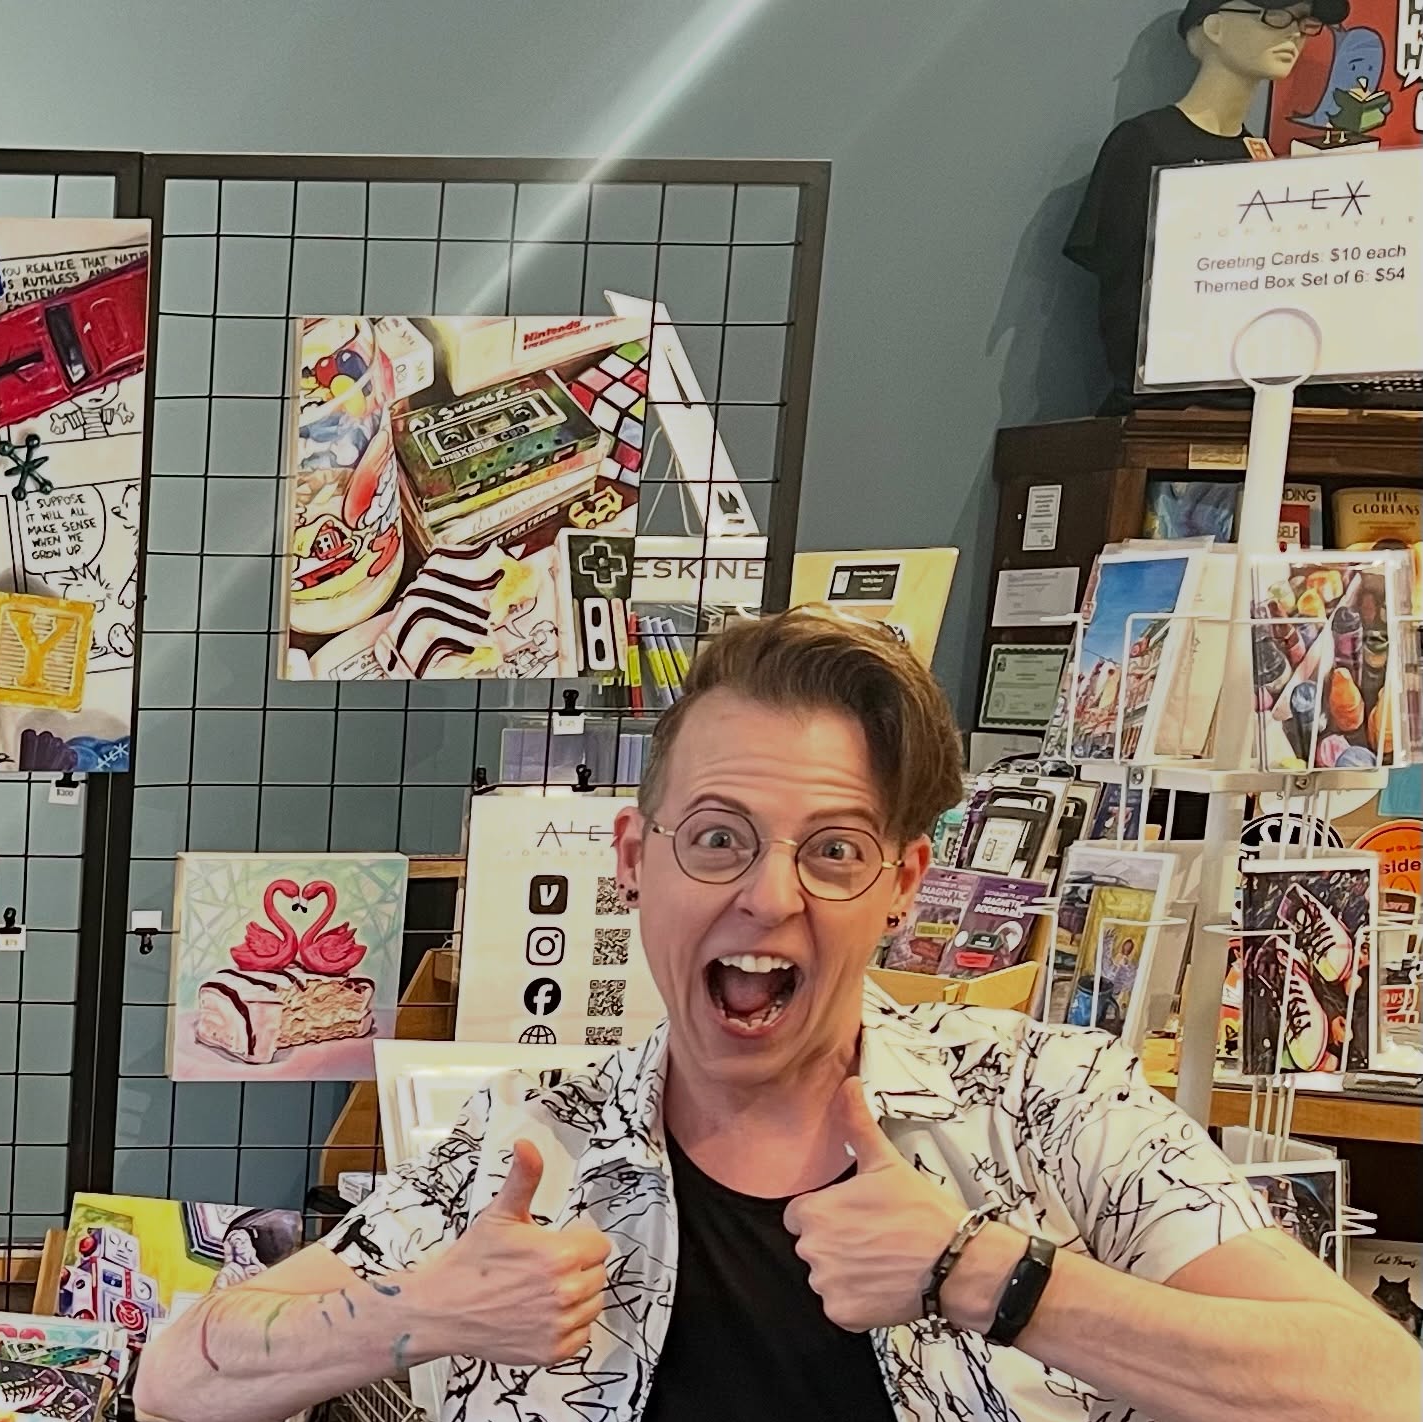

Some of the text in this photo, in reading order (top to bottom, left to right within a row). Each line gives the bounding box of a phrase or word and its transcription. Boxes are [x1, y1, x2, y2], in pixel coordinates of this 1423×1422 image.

[1237, 180, 1370, 224] ALEX
[26, 258, 75, 274] REALIZE
[81, 256, 108, 269] THAT
[1196, 255, 1266, 272] Greeting
[1330, 246, 1361, 262] $10
[1366, 244, 1407, 260] each
[22, 272, 80, 289] RUTHLESS
[1194, 277, 1259, 294] Themed
[1264, 275, 1295, 289] Box
[1301, 271, 1328, 287] Set
[1334, 270, 1350, 284] of
[1375, 266, 1406, 282] $54
[523, 319, 582, 343] Nintendo
[37, 494, 85, 508] SUPPOSE
[1375, 492, 1399, 501] THE
[26, 508, 88, 522] IT WILL ALL
[1352, 504, 1421, 516] GLORIANS
[28, 518, 97, 535] MAKE SENSE
[32, 532, 84, 548] WHEN WE
[32, 549, 61, 560] GROW
[9, 609, 78, 688] Y
